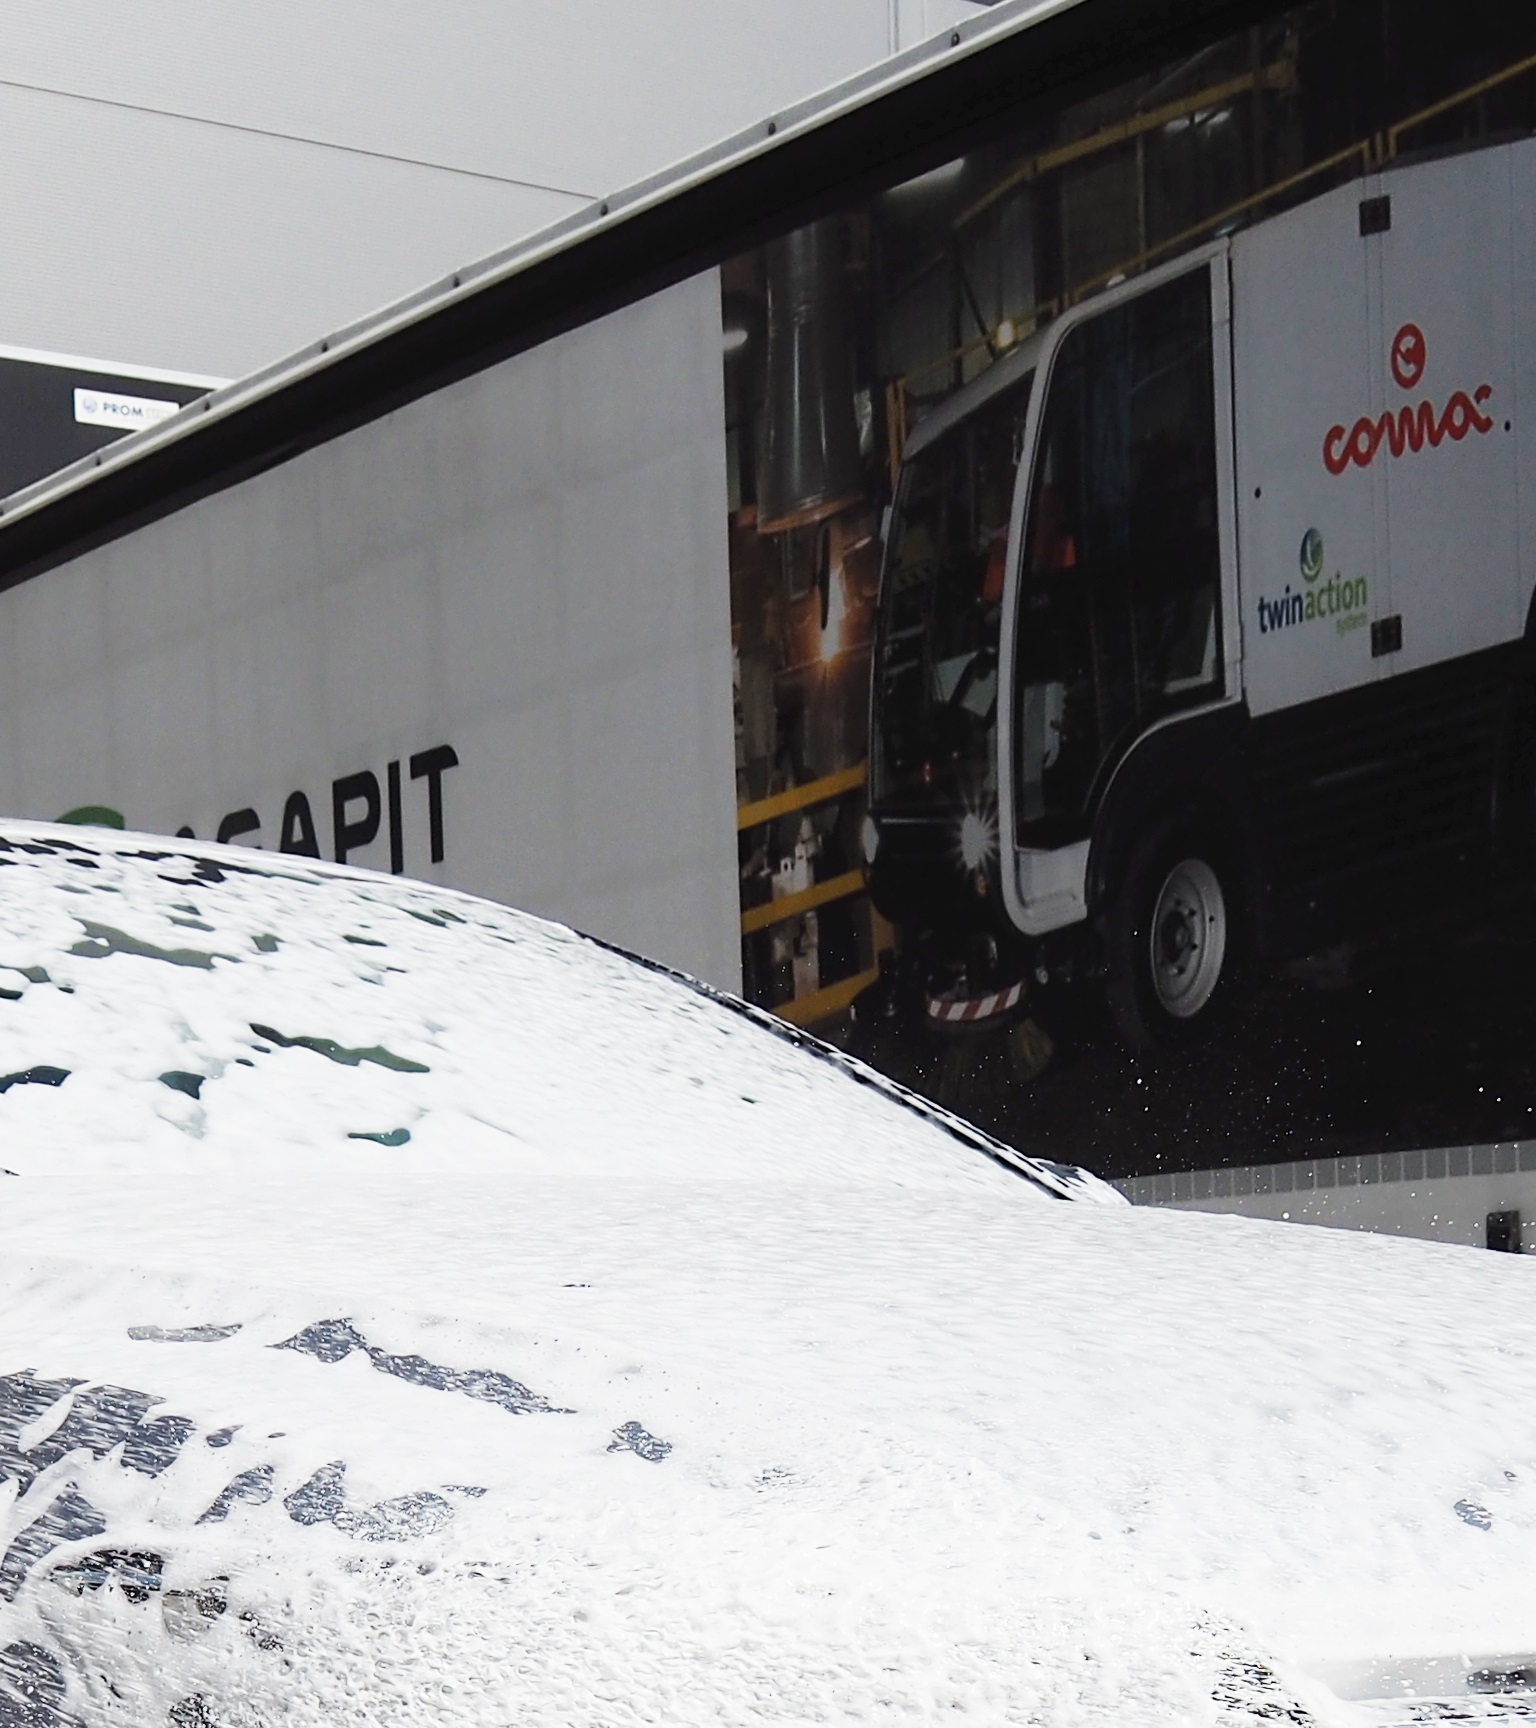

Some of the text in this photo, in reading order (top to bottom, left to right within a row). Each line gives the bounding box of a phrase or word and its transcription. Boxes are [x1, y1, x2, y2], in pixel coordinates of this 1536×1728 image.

[1322, 384, 1494, 476] comac
[1257, 570, 1367, 635] twinaction
[174, 743, 460, 875] APIT
